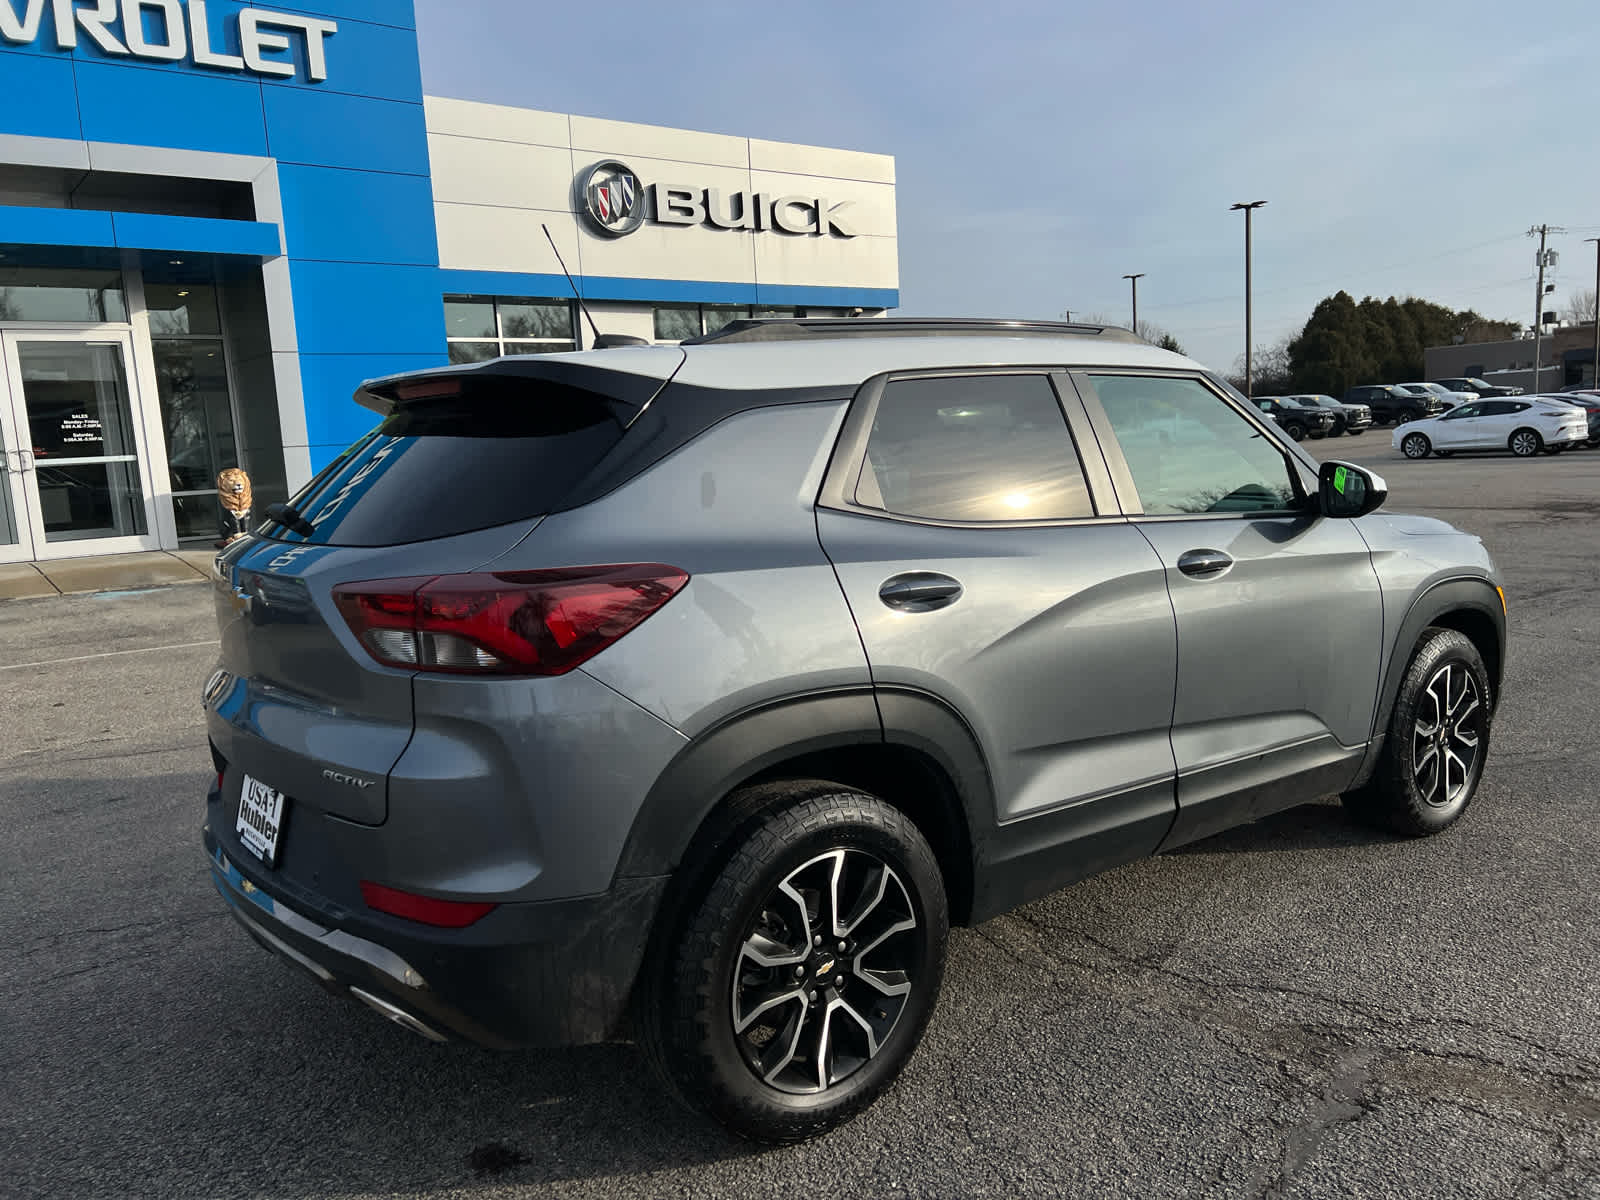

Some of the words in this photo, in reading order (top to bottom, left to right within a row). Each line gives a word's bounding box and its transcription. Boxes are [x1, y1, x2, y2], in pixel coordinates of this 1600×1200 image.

[648, 183, 856, 238] BUICK
[323, 769, 376, 788] ACTIV
[240, 800, 278, 844] Hubler
